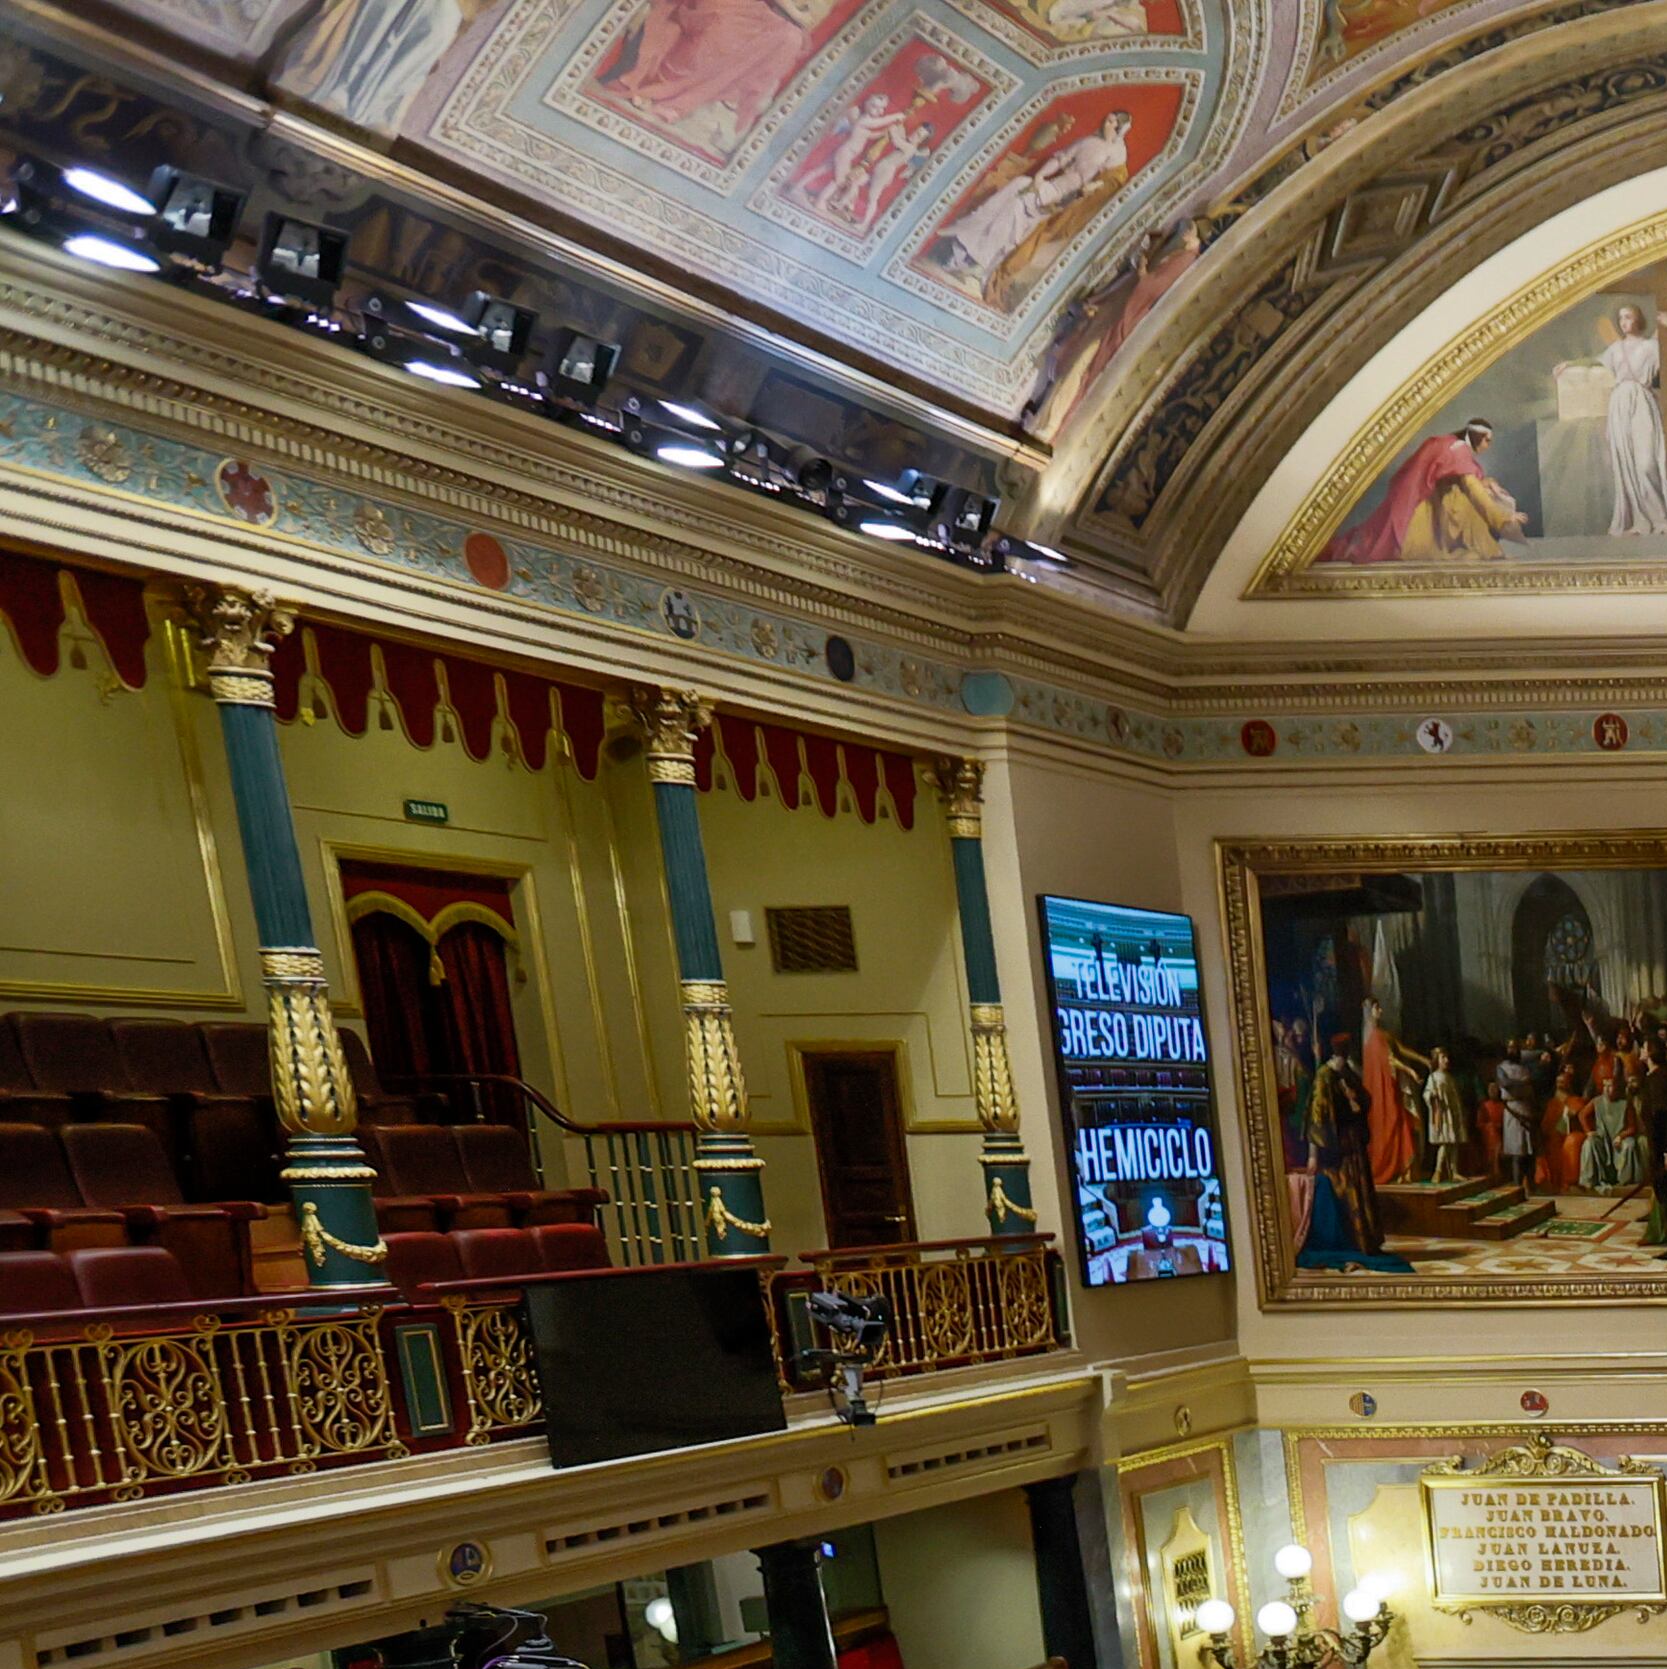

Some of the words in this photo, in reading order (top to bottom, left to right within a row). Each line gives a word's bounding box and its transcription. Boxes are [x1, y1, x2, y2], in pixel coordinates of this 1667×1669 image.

[1074, 958, 1182, 1007] TELEVISIÓN
[1134, 1014, 1206, 1062] DIPUTA
[1079, 1128, 1213, 1182] HEMICICLO
[1461, 1493, 1508, 1506] JUAN
[1516, 1493, 1542, 1506] DE
[1547, 1492, 1635, 1506] PADILLA.
[1486, 1509, 1533, 1522] JUAN
[1541, 1509, 1609, 1522] BRAVO.
[1440, 1526, 1536, 1539] FRANCISCO
[1546, 1525, 1656, 1538] MALDONADO.
[1478, 1543, 1528, 1555] JUAN
[1538, 1542, 1620, 1555] LANUZA.
[1473, 1560, 1532, 1572] DIEGO
[1542, 1559, 1631, 1572] HEREDIA.
[1480, 1576, 1530, 1588] JUAN
[1539, 1576, 1563, 1588] DE
[1572, 1575, 1627, 1588] LUNA.
